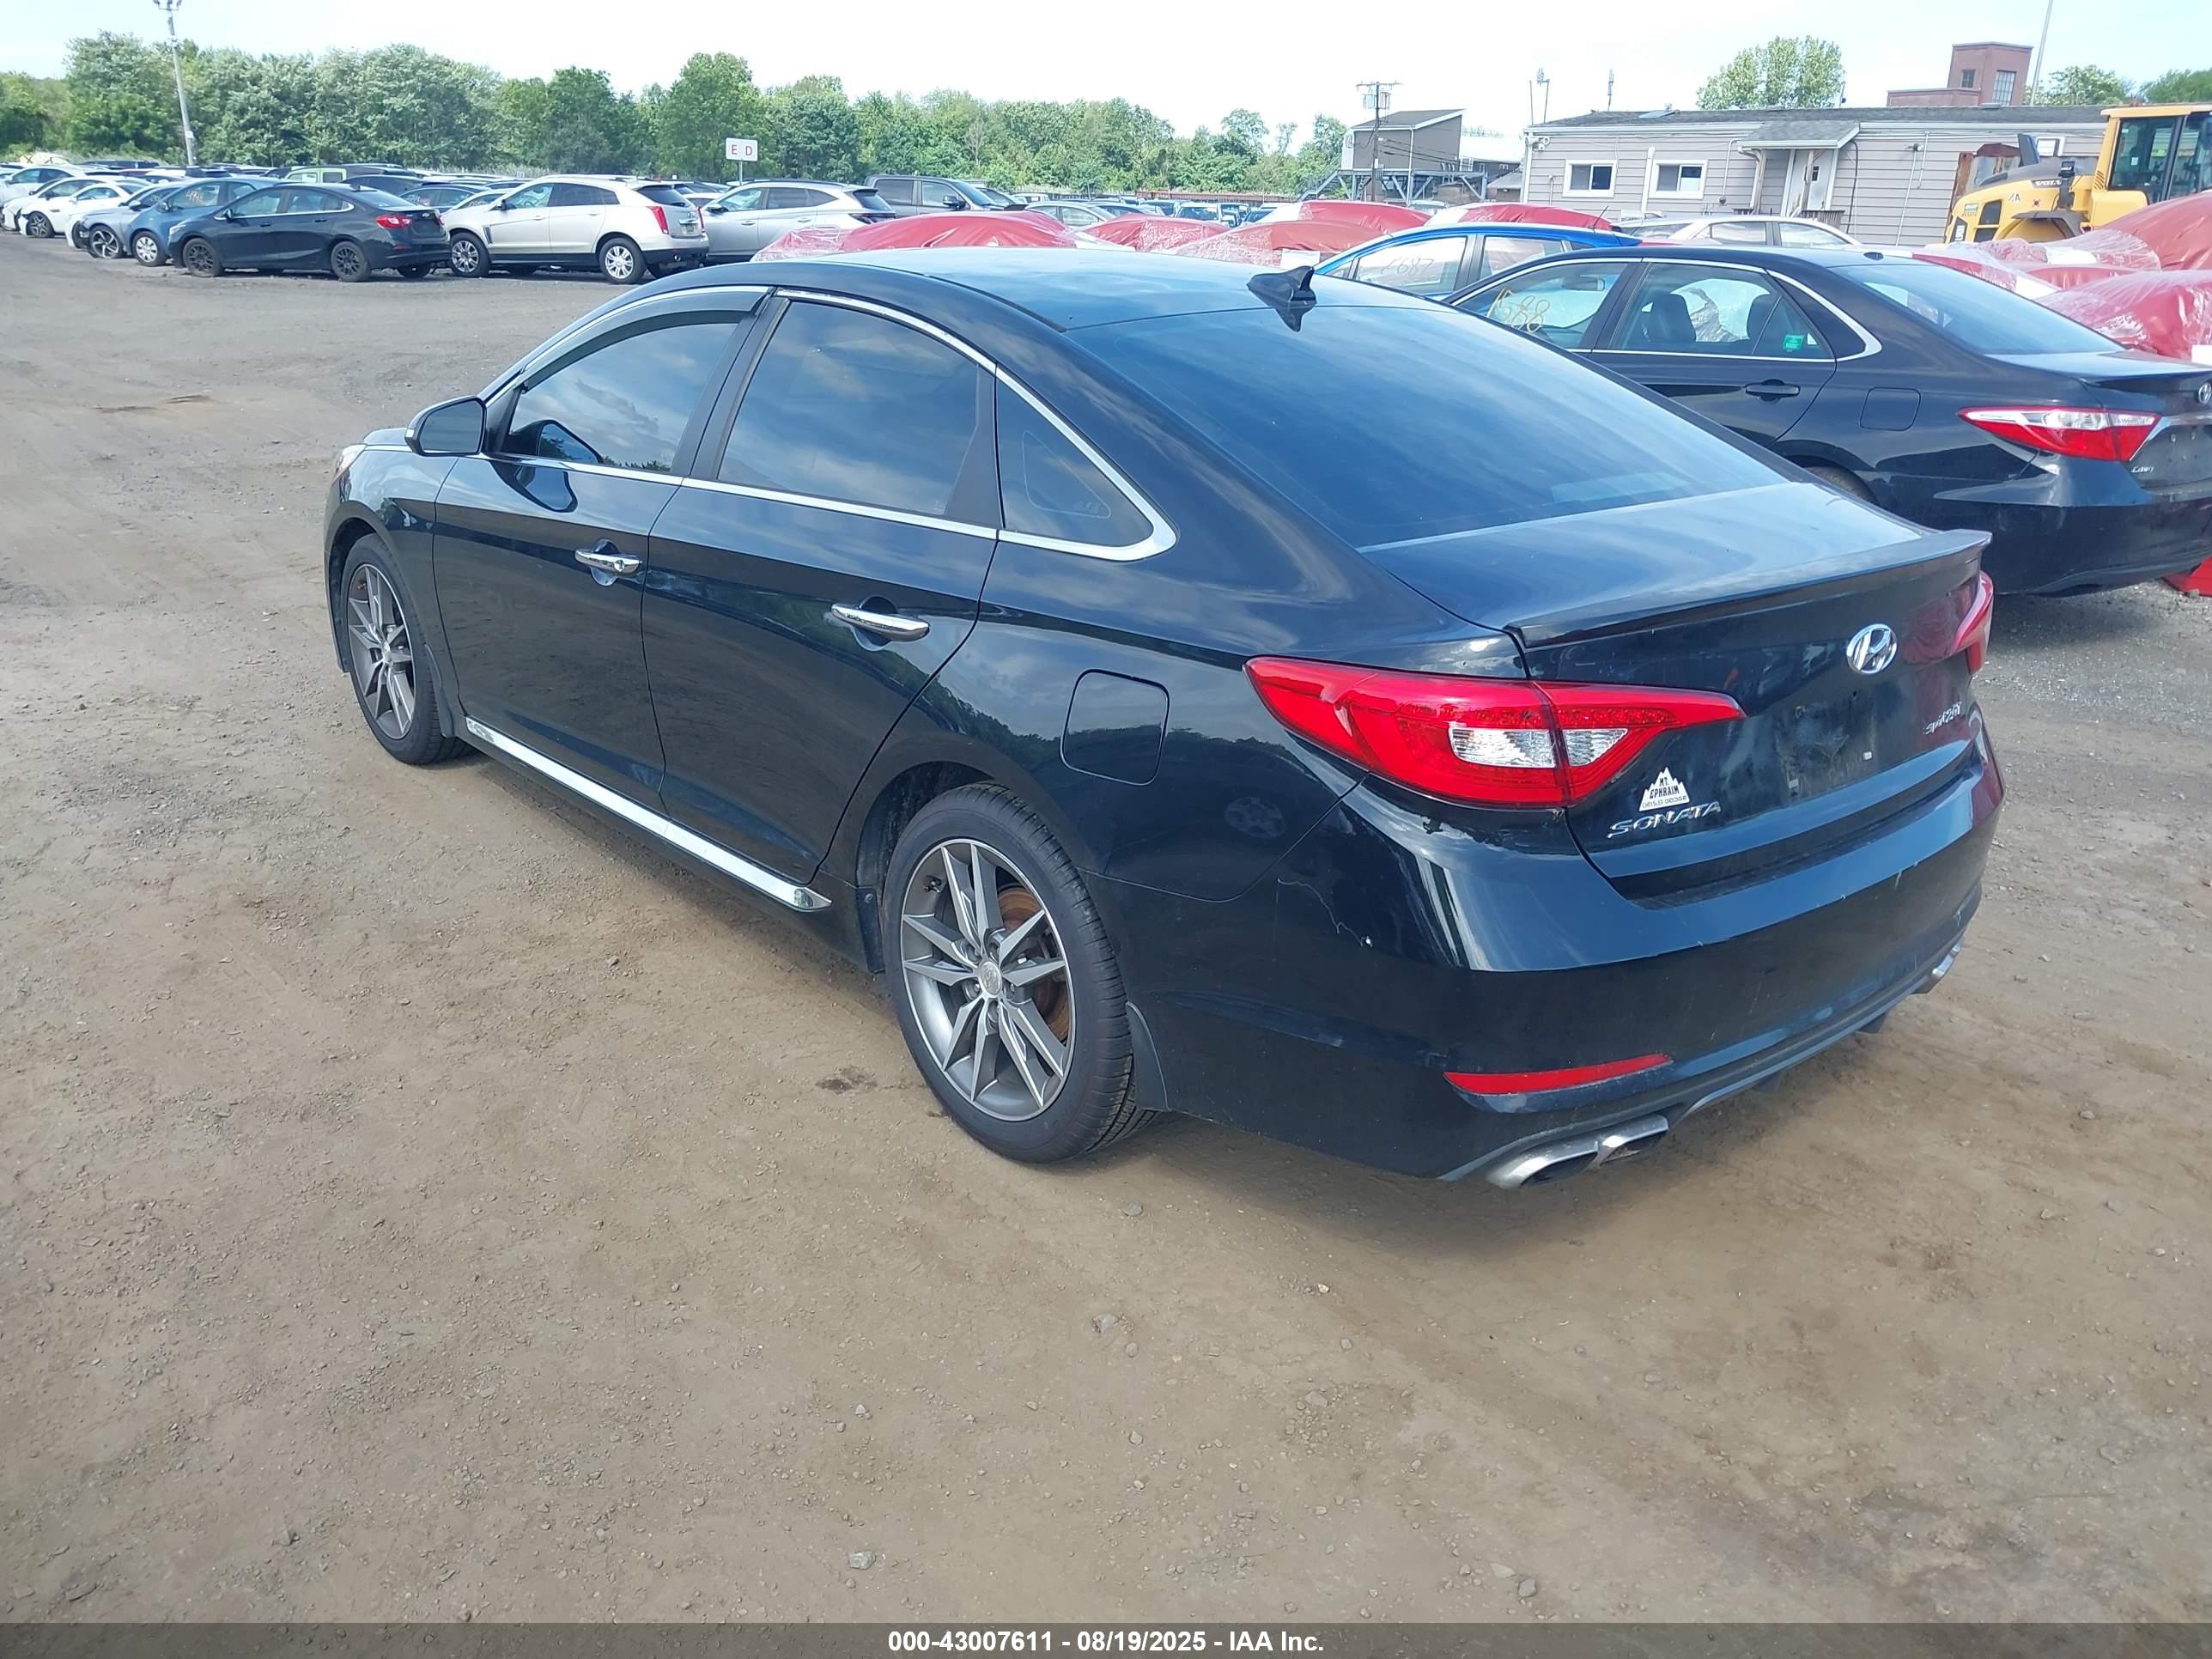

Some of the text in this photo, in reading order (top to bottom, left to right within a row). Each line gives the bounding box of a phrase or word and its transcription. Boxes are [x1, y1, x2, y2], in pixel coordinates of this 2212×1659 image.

[731, 143, 753, 156] E D
[1650, 785, 1680, 799] EPHRAIM
[1607, 801, 1721, 838] SONATA
